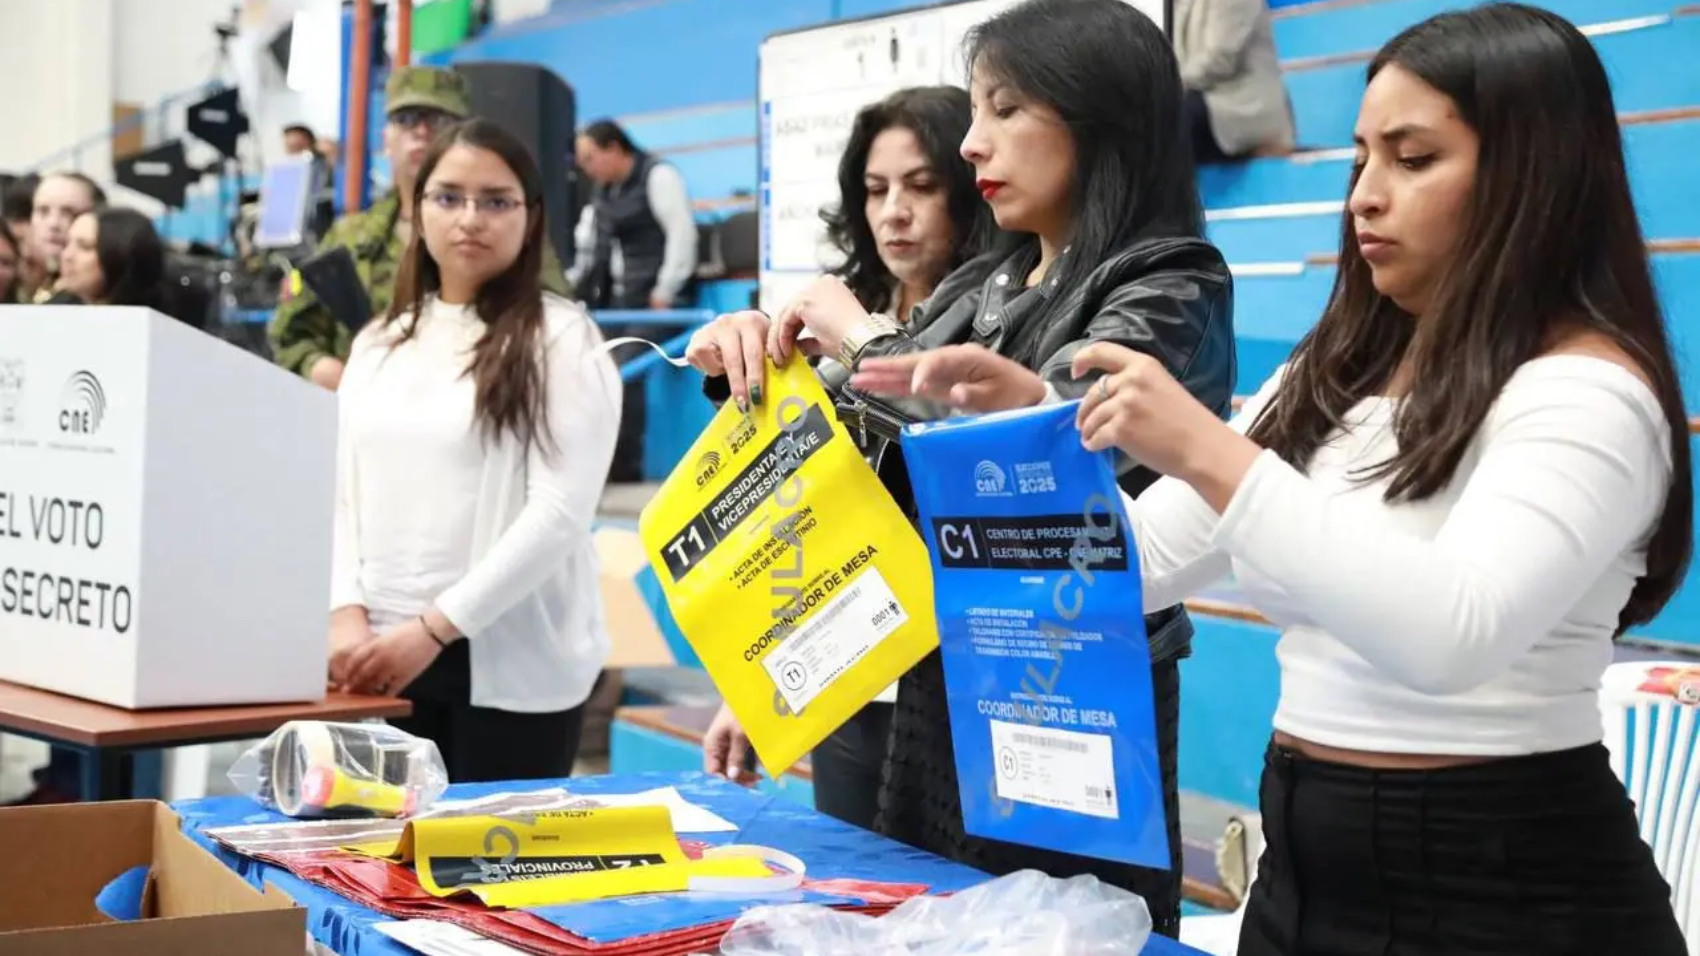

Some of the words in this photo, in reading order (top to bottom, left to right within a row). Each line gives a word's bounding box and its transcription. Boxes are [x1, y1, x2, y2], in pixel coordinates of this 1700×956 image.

[730, 425, 758, 455] 2025
[1019, 477, 1057, 494] 2025
[0, 492, 22, 538] EL
[29, 494, 104, 549] VOTO
[986, 528, 1021, 540] CENTRO
[1021, 528, 1035, 540] DE
[1035, 526, 1117, 540] PROCESAM
[668, 525, 707, 567] T1
[941, 523, 979, 559] C1
[991, 547, 1042, 560] ELECTORAL
[1043, 547, 1063, 559] CPE
[1090, 546, 1122, 559] ATRIZ
[733, 559, 754, 580] ACTA
[752, 547, 764, 562] DE
[771, 395, 808, 718] SMULACRO
[740, 568, 762, 588] ACTA
[760, 557, 773, 572] DE
[1, 566, 132, 634] SECRETO
[743, 587, 826, 662] COORDINADOR
[823, 574, 843, 593] DE
[841, 544, 879, 577] MESA
[871, 608, 891, 627] 0001
[786, 668, 802, 684] T1
[1061, 708, 1079, 724] DE
[1080, 708, 1118, 728] MESA
[1003, 754, 1014, 772] C1
[480, 860, 595, 875] PROVINCIALES
